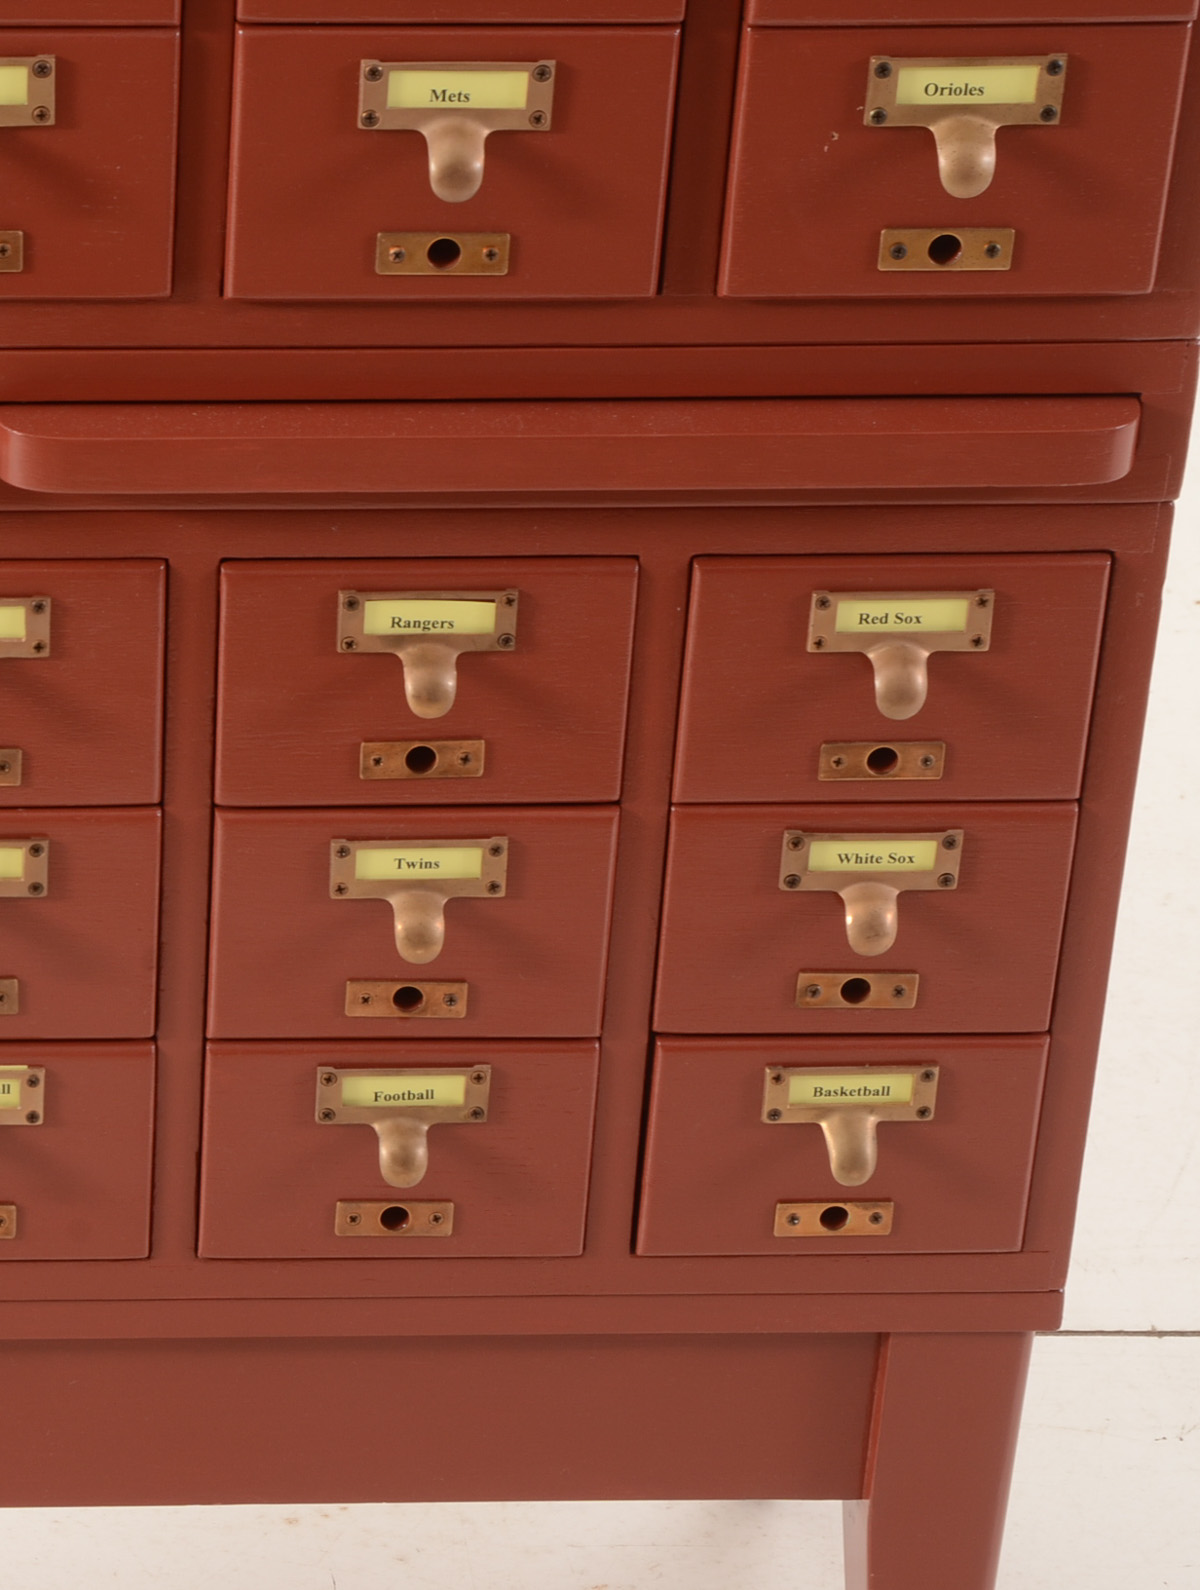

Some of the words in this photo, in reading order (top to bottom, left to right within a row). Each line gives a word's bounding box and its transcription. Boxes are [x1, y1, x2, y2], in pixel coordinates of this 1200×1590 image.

[429, 88, 471, 104] Mets
[924, 82, 985, 98] Orioles
[390, 616, 455, 632] Rangers
[858, 612, 889, 625] Red
[893, 612, 923, 625] Sox
[394, 858, 440, 870] Twins
[837, 852, 884, 865] White
[887, 852, 915, 865] Sox
[373, 1089, 435, 1102] Football
[812, 1085, 891, 1098] Basketball
